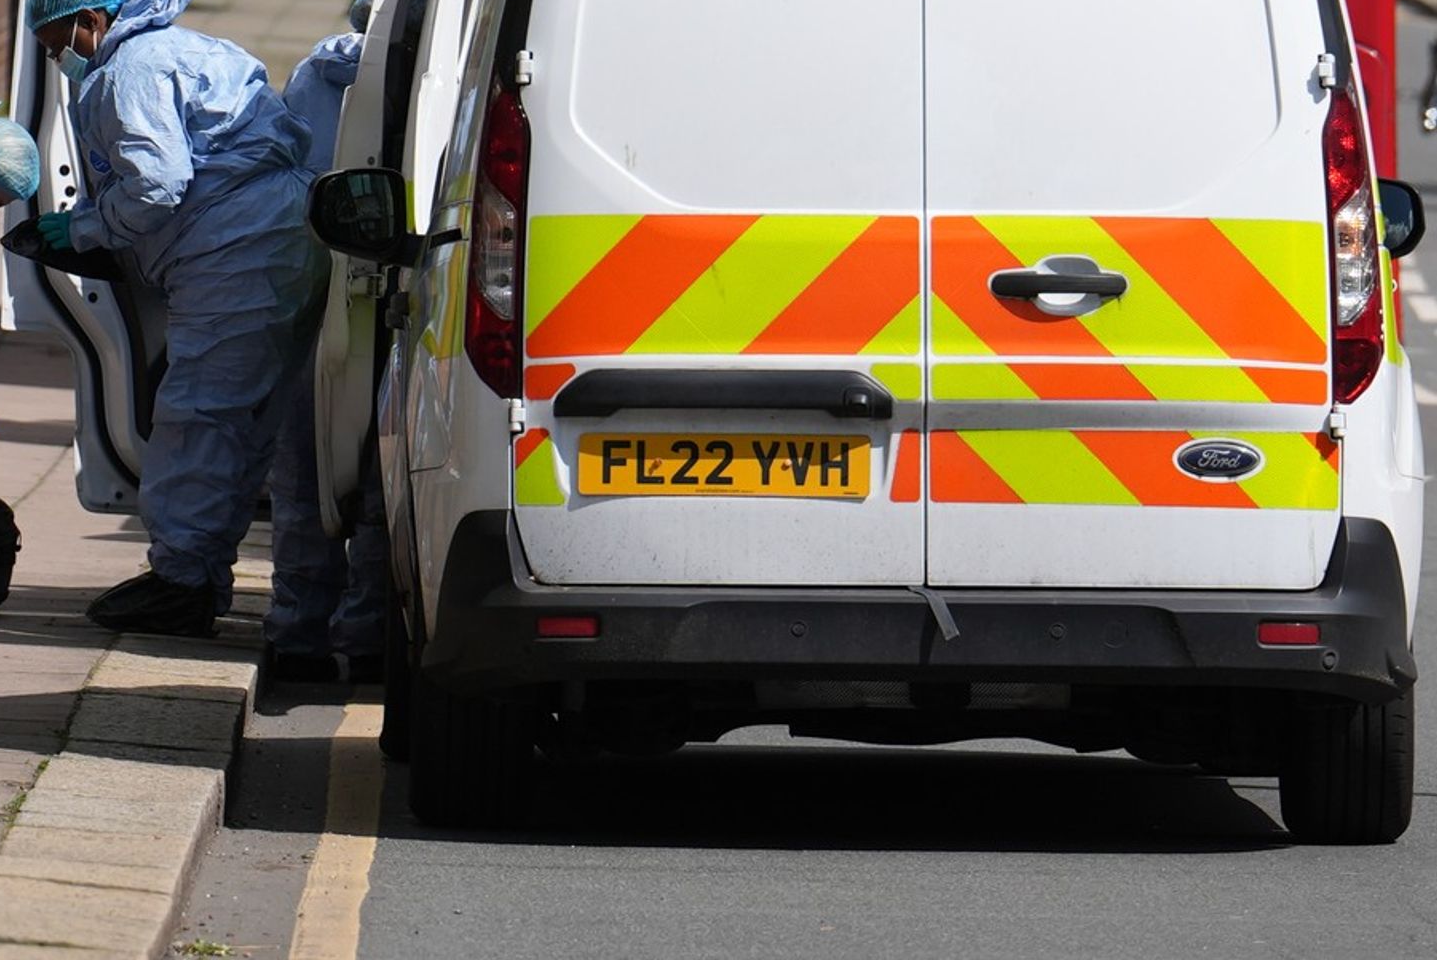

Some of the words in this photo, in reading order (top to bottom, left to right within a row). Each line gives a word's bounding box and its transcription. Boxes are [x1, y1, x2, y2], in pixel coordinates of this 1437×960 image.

[601, 440, 733, 485] FL22
[752, 441, 850, 487] YVH
[1197, 448, 1243, 469] Ford
